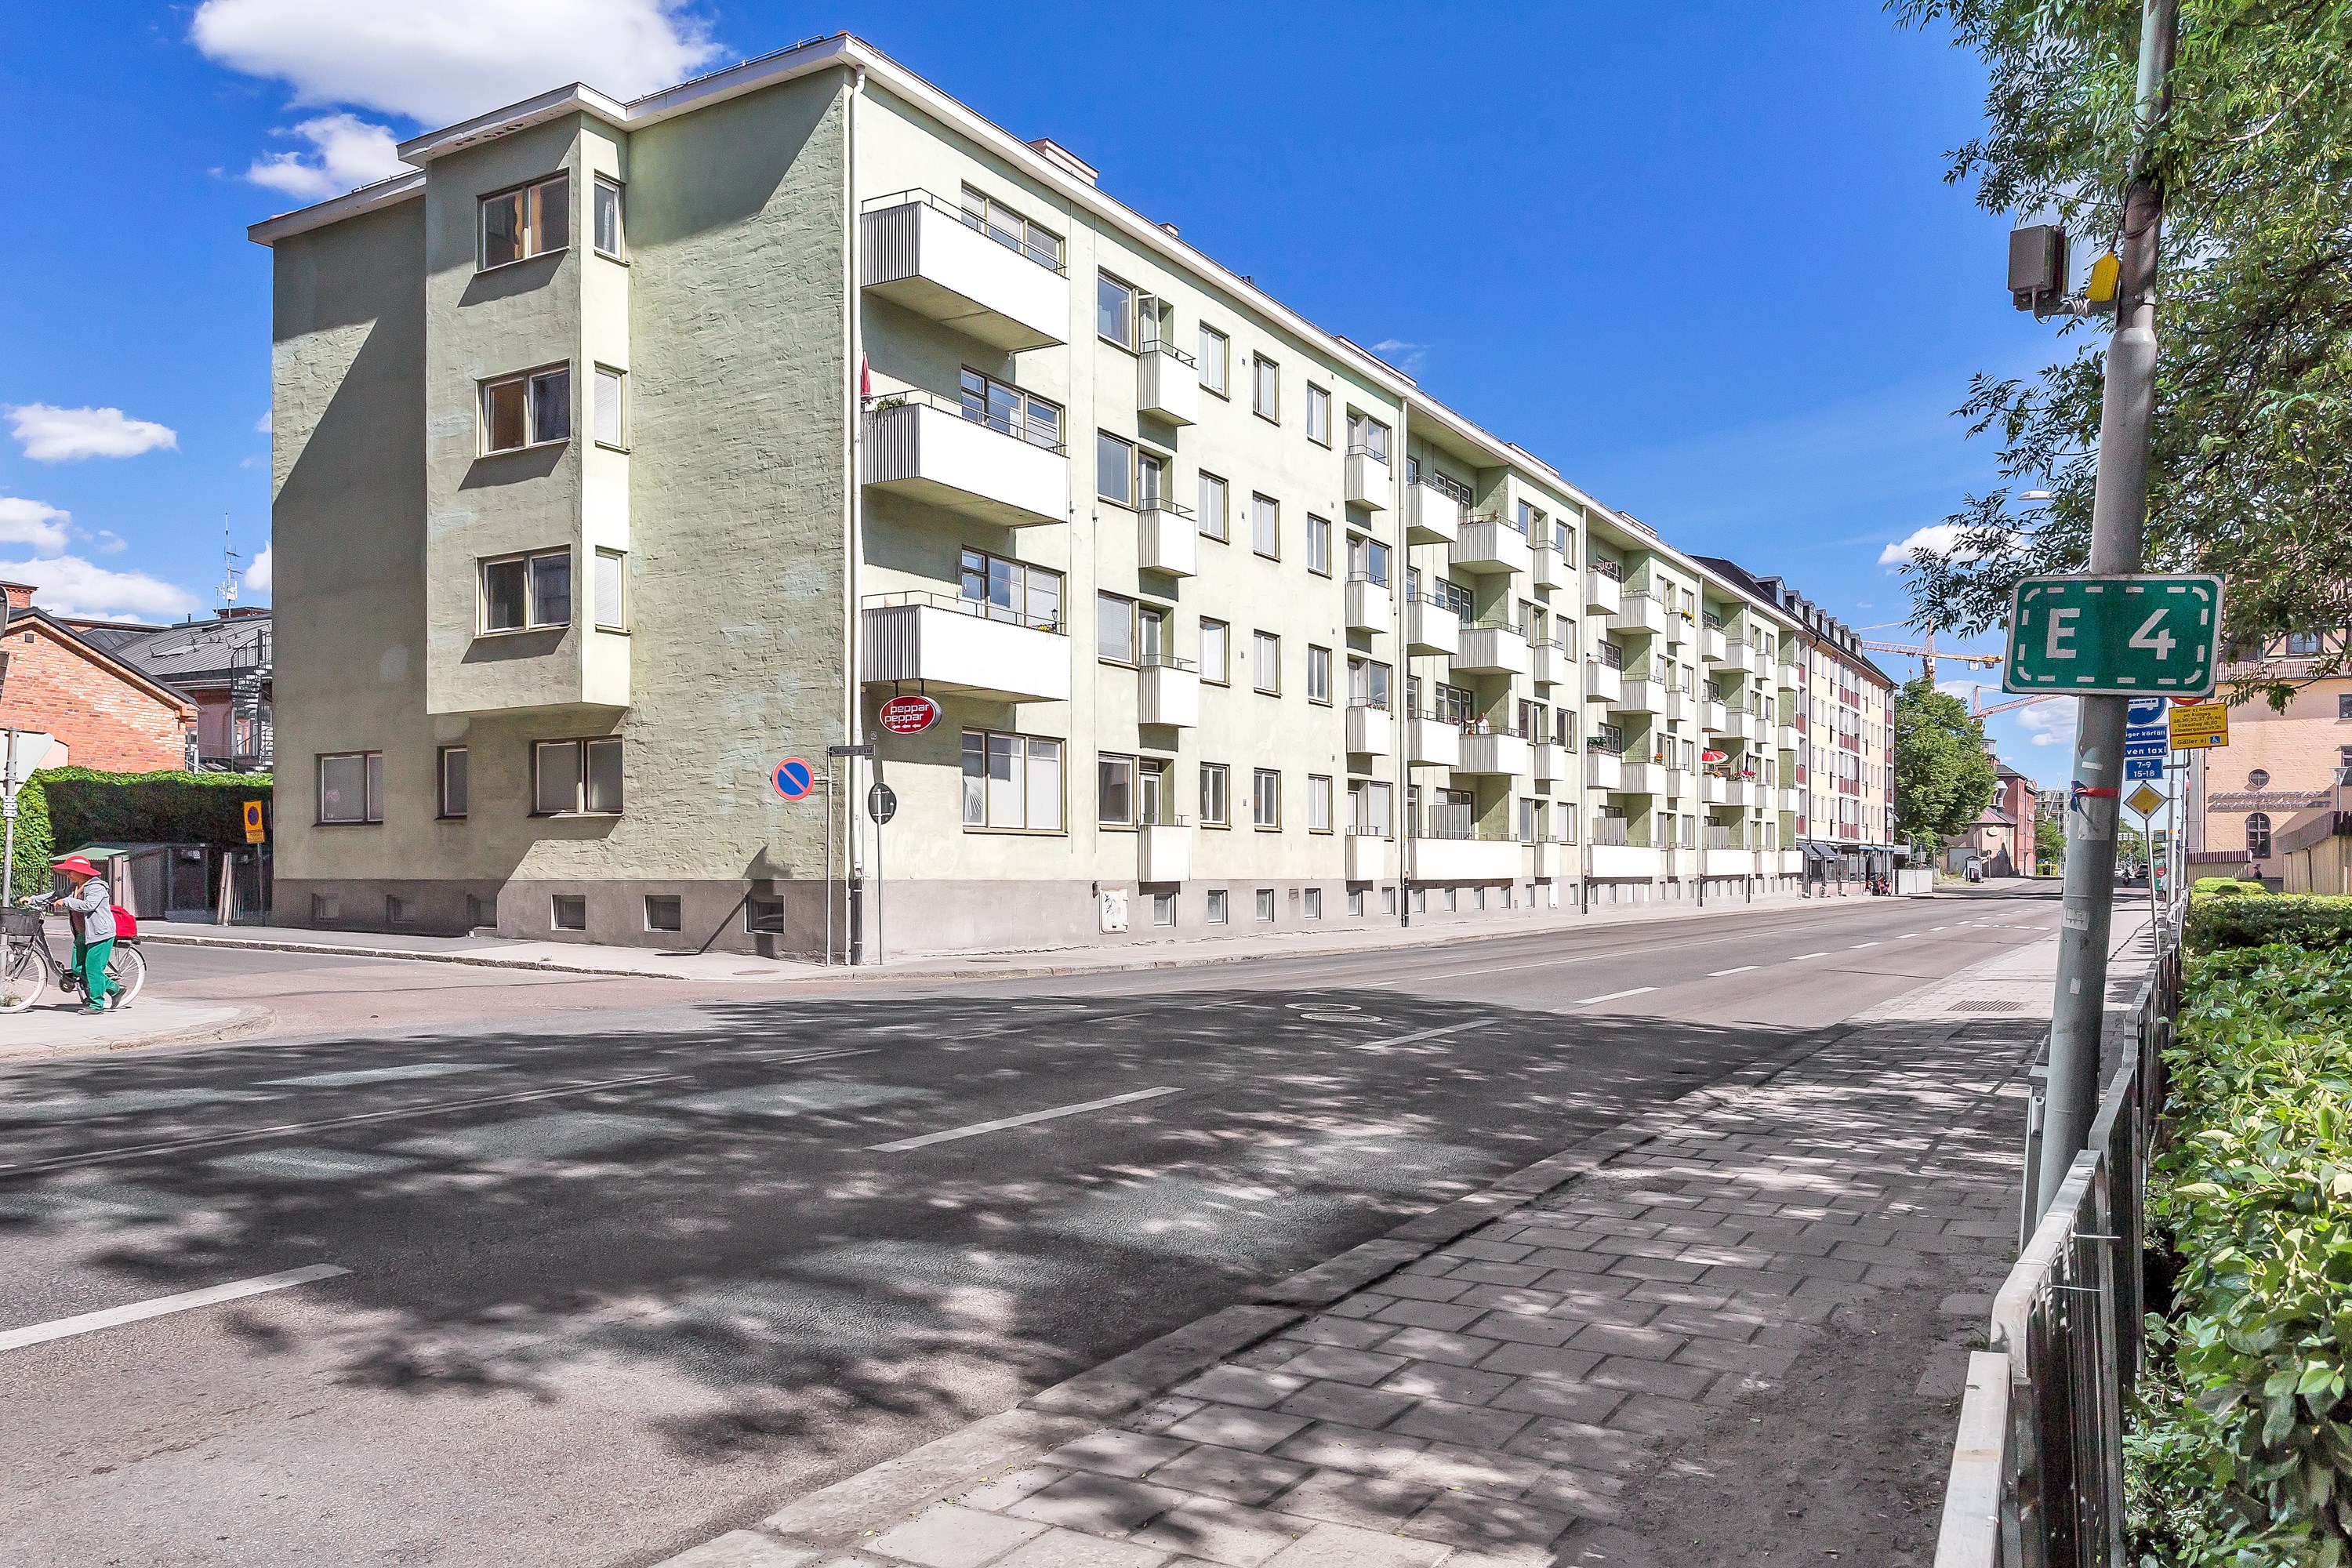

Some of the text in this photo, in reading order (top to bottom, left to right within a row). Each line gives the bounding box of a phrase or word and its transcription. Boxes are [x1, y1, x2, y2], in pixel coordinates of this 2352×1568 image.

[2045, 608, 2176, 660] E 4
[890, 704, 930, 715] peppar
[884, 713, 924, 724] peppar
